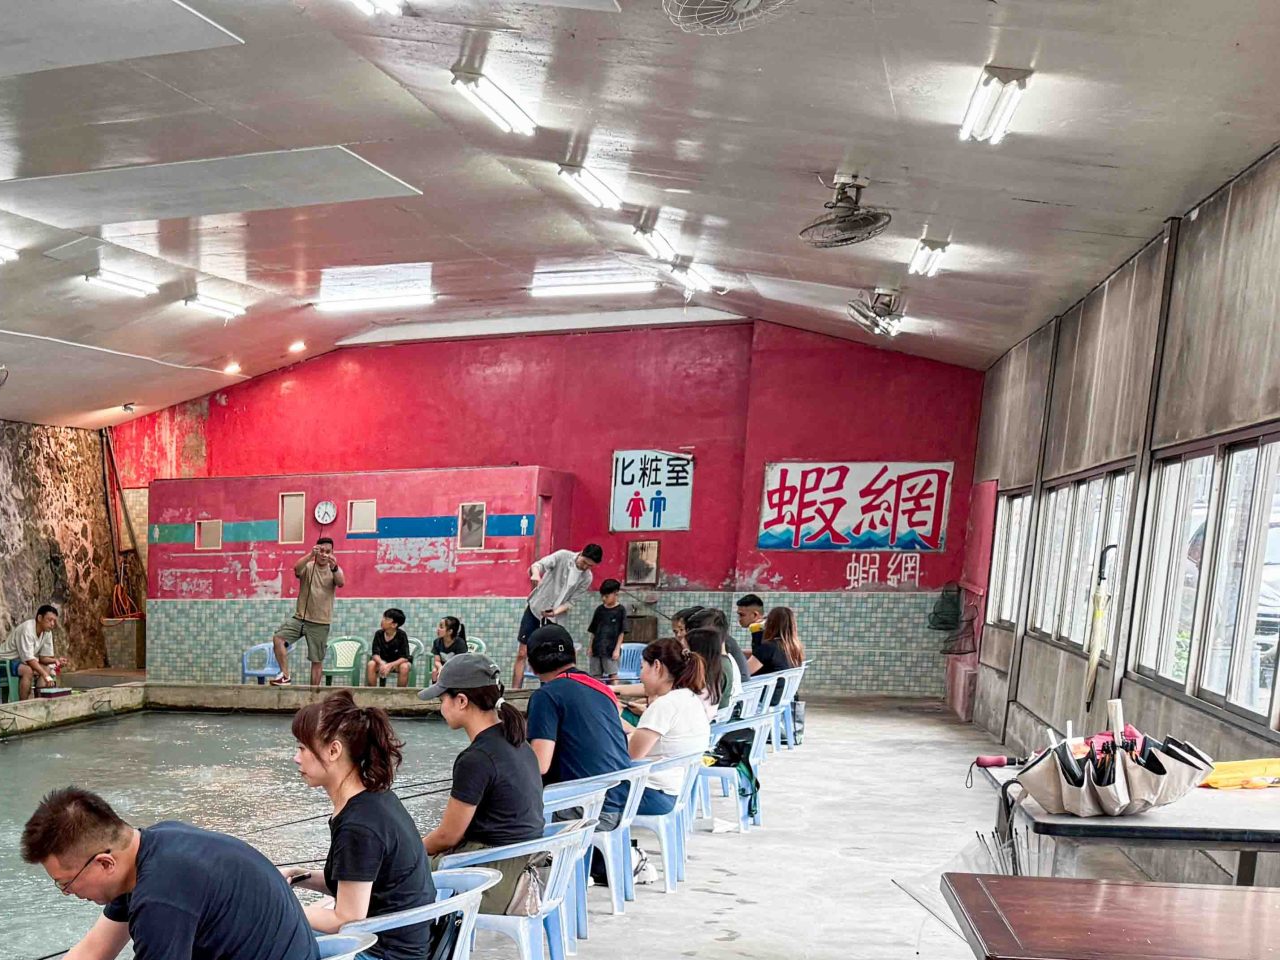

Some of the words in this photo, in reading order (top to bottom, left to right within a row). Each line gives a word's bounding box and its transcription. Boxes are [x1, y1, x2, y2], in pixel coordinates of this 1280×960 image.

[614, 454, 690, 489] 化粧室
[763, 464, 952, 549] 蝦網
